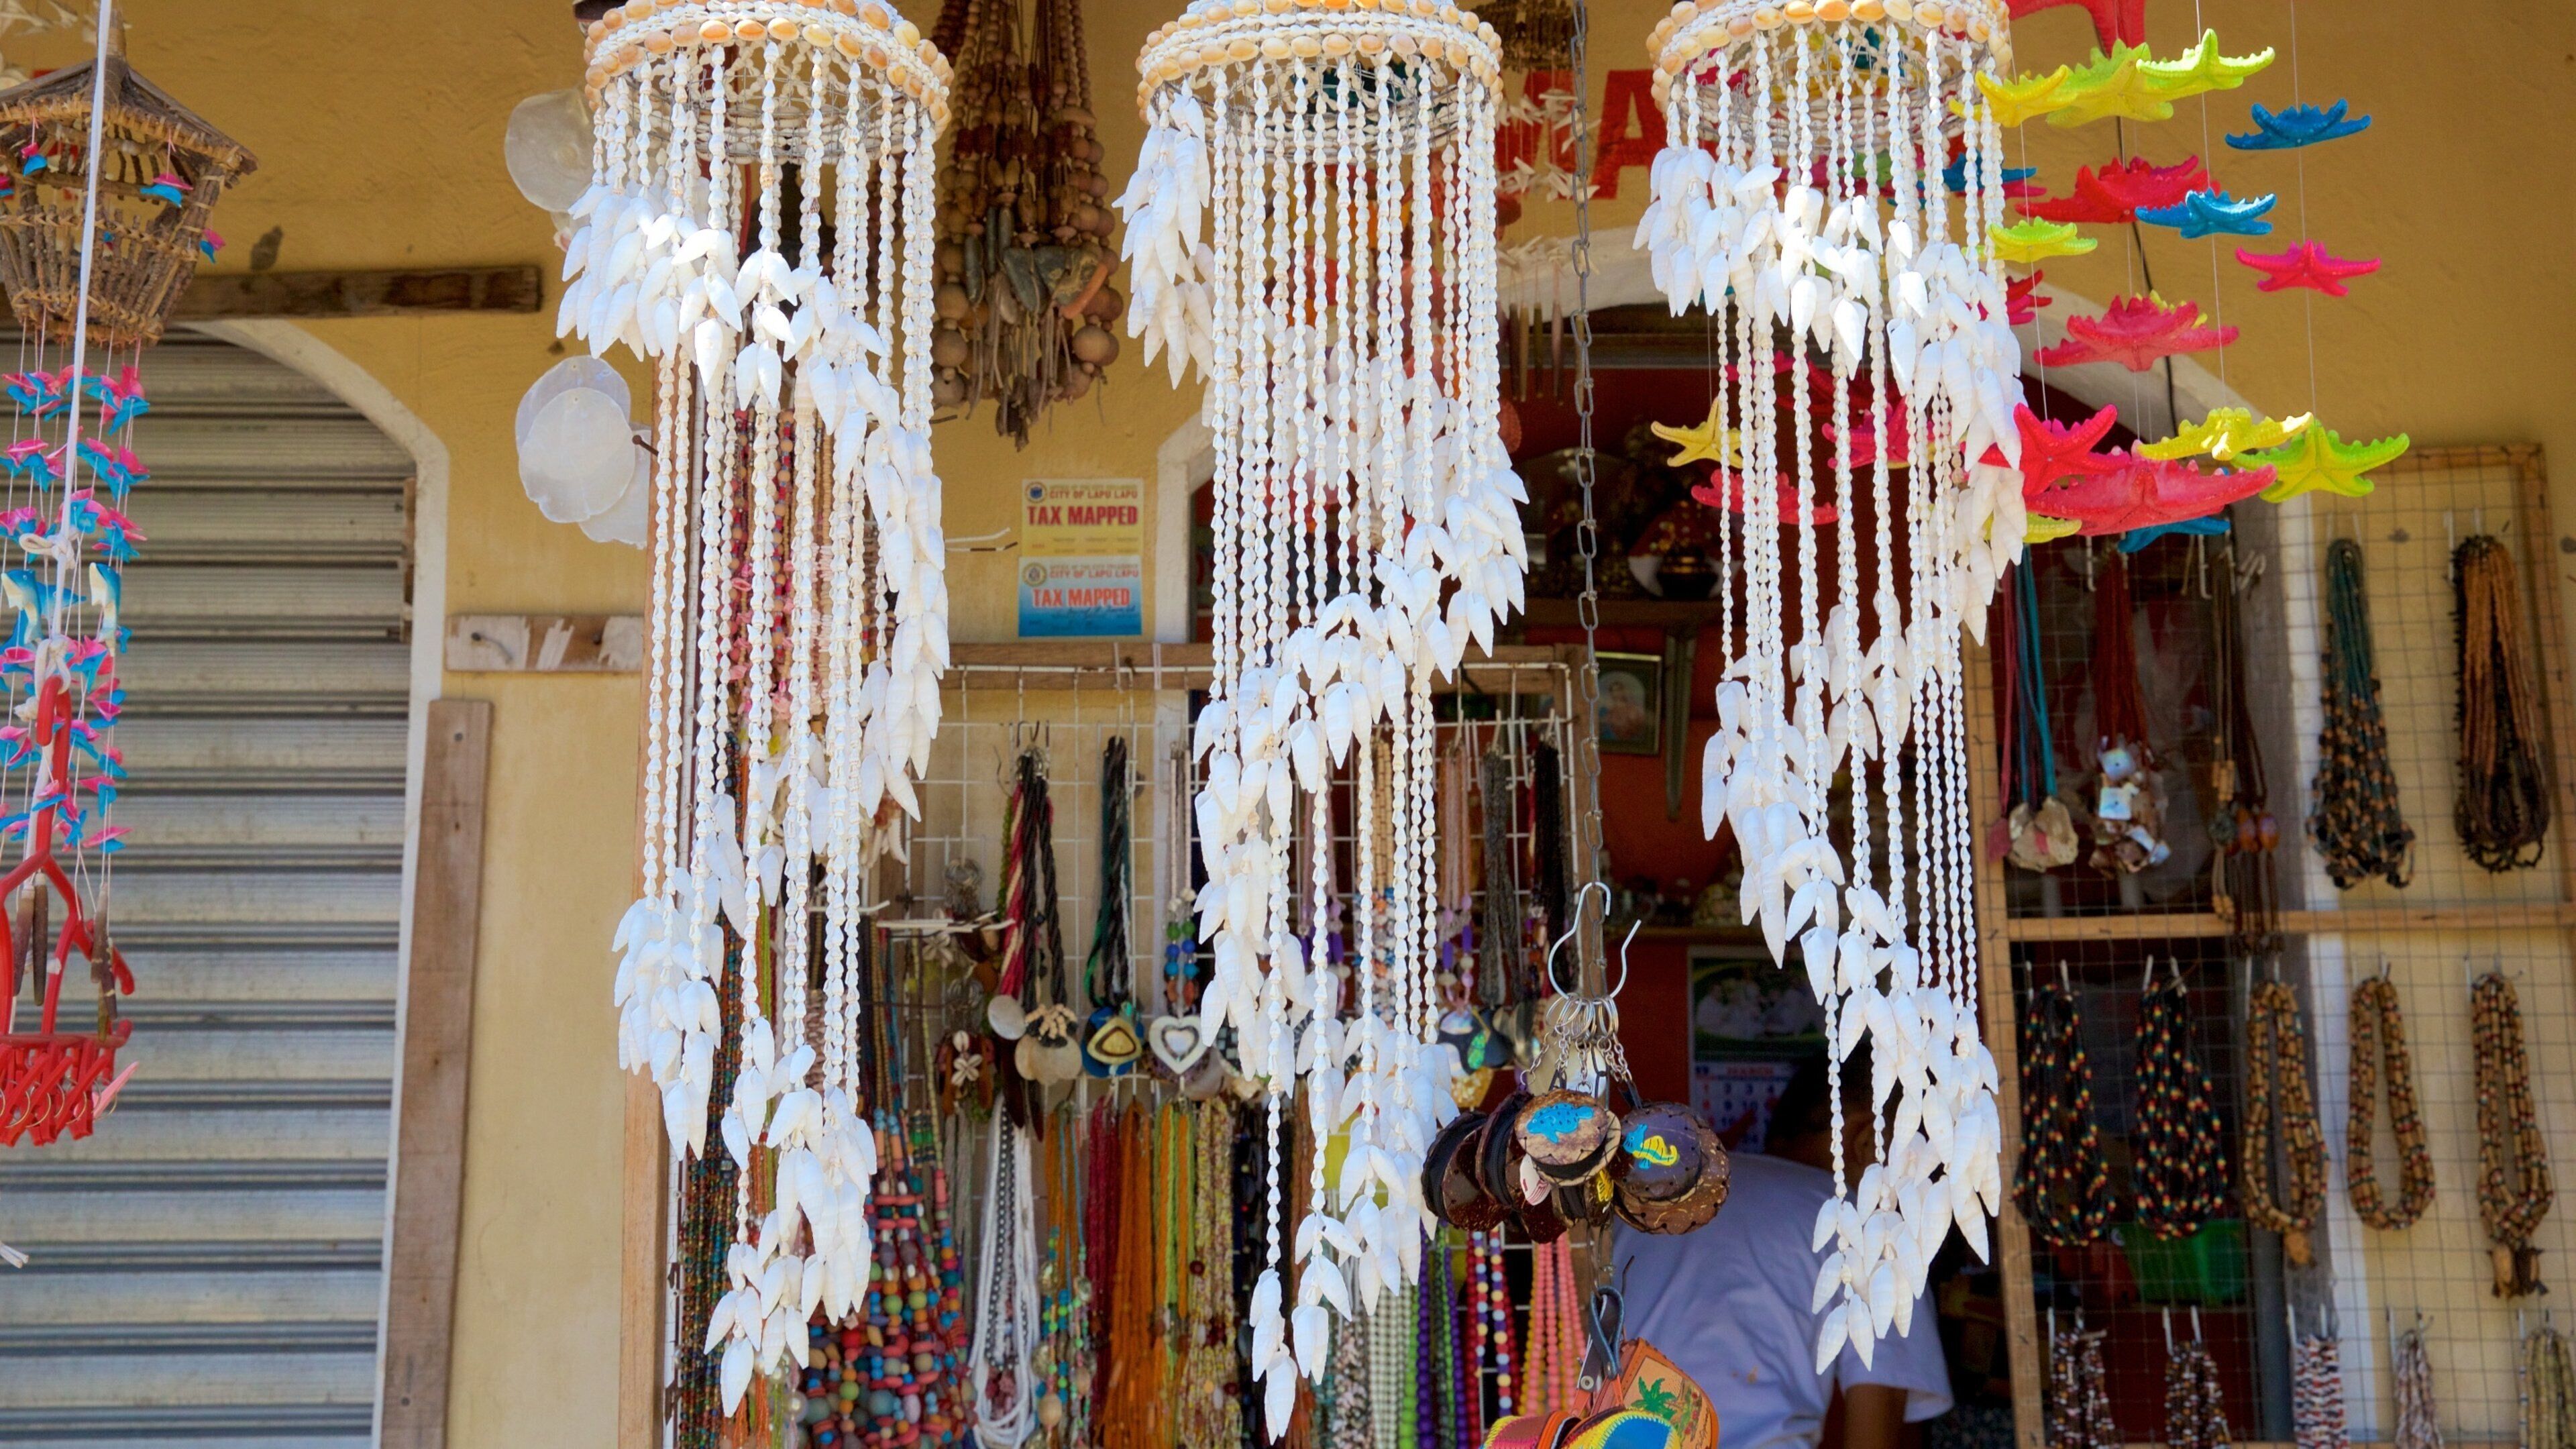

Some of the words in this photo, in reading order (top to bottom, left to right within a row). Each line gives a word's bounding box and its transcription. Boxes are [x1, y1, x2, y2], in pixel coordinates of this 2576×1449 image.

[1050, 490, 1069, 498] CITY
[1073, 490, 1084, 498] OF
[1087, 490, 1111, 498] LAPU
[1114, 490, 1138, 498] LAPU
[1027, 506, 1061, 525] TAX
[1068, 506, 1138, 525] MAPPED
[1050, 570, 1069, 578] CITY
[1073, 570, 1084, 578] OF
[1088, 569, 1112, 578] LAPU
[1116, 569, 1138, 578] LAPU
[1033, 588, 1063, 606] TAX
[1068, 588, 1130, 606] MAPPED
